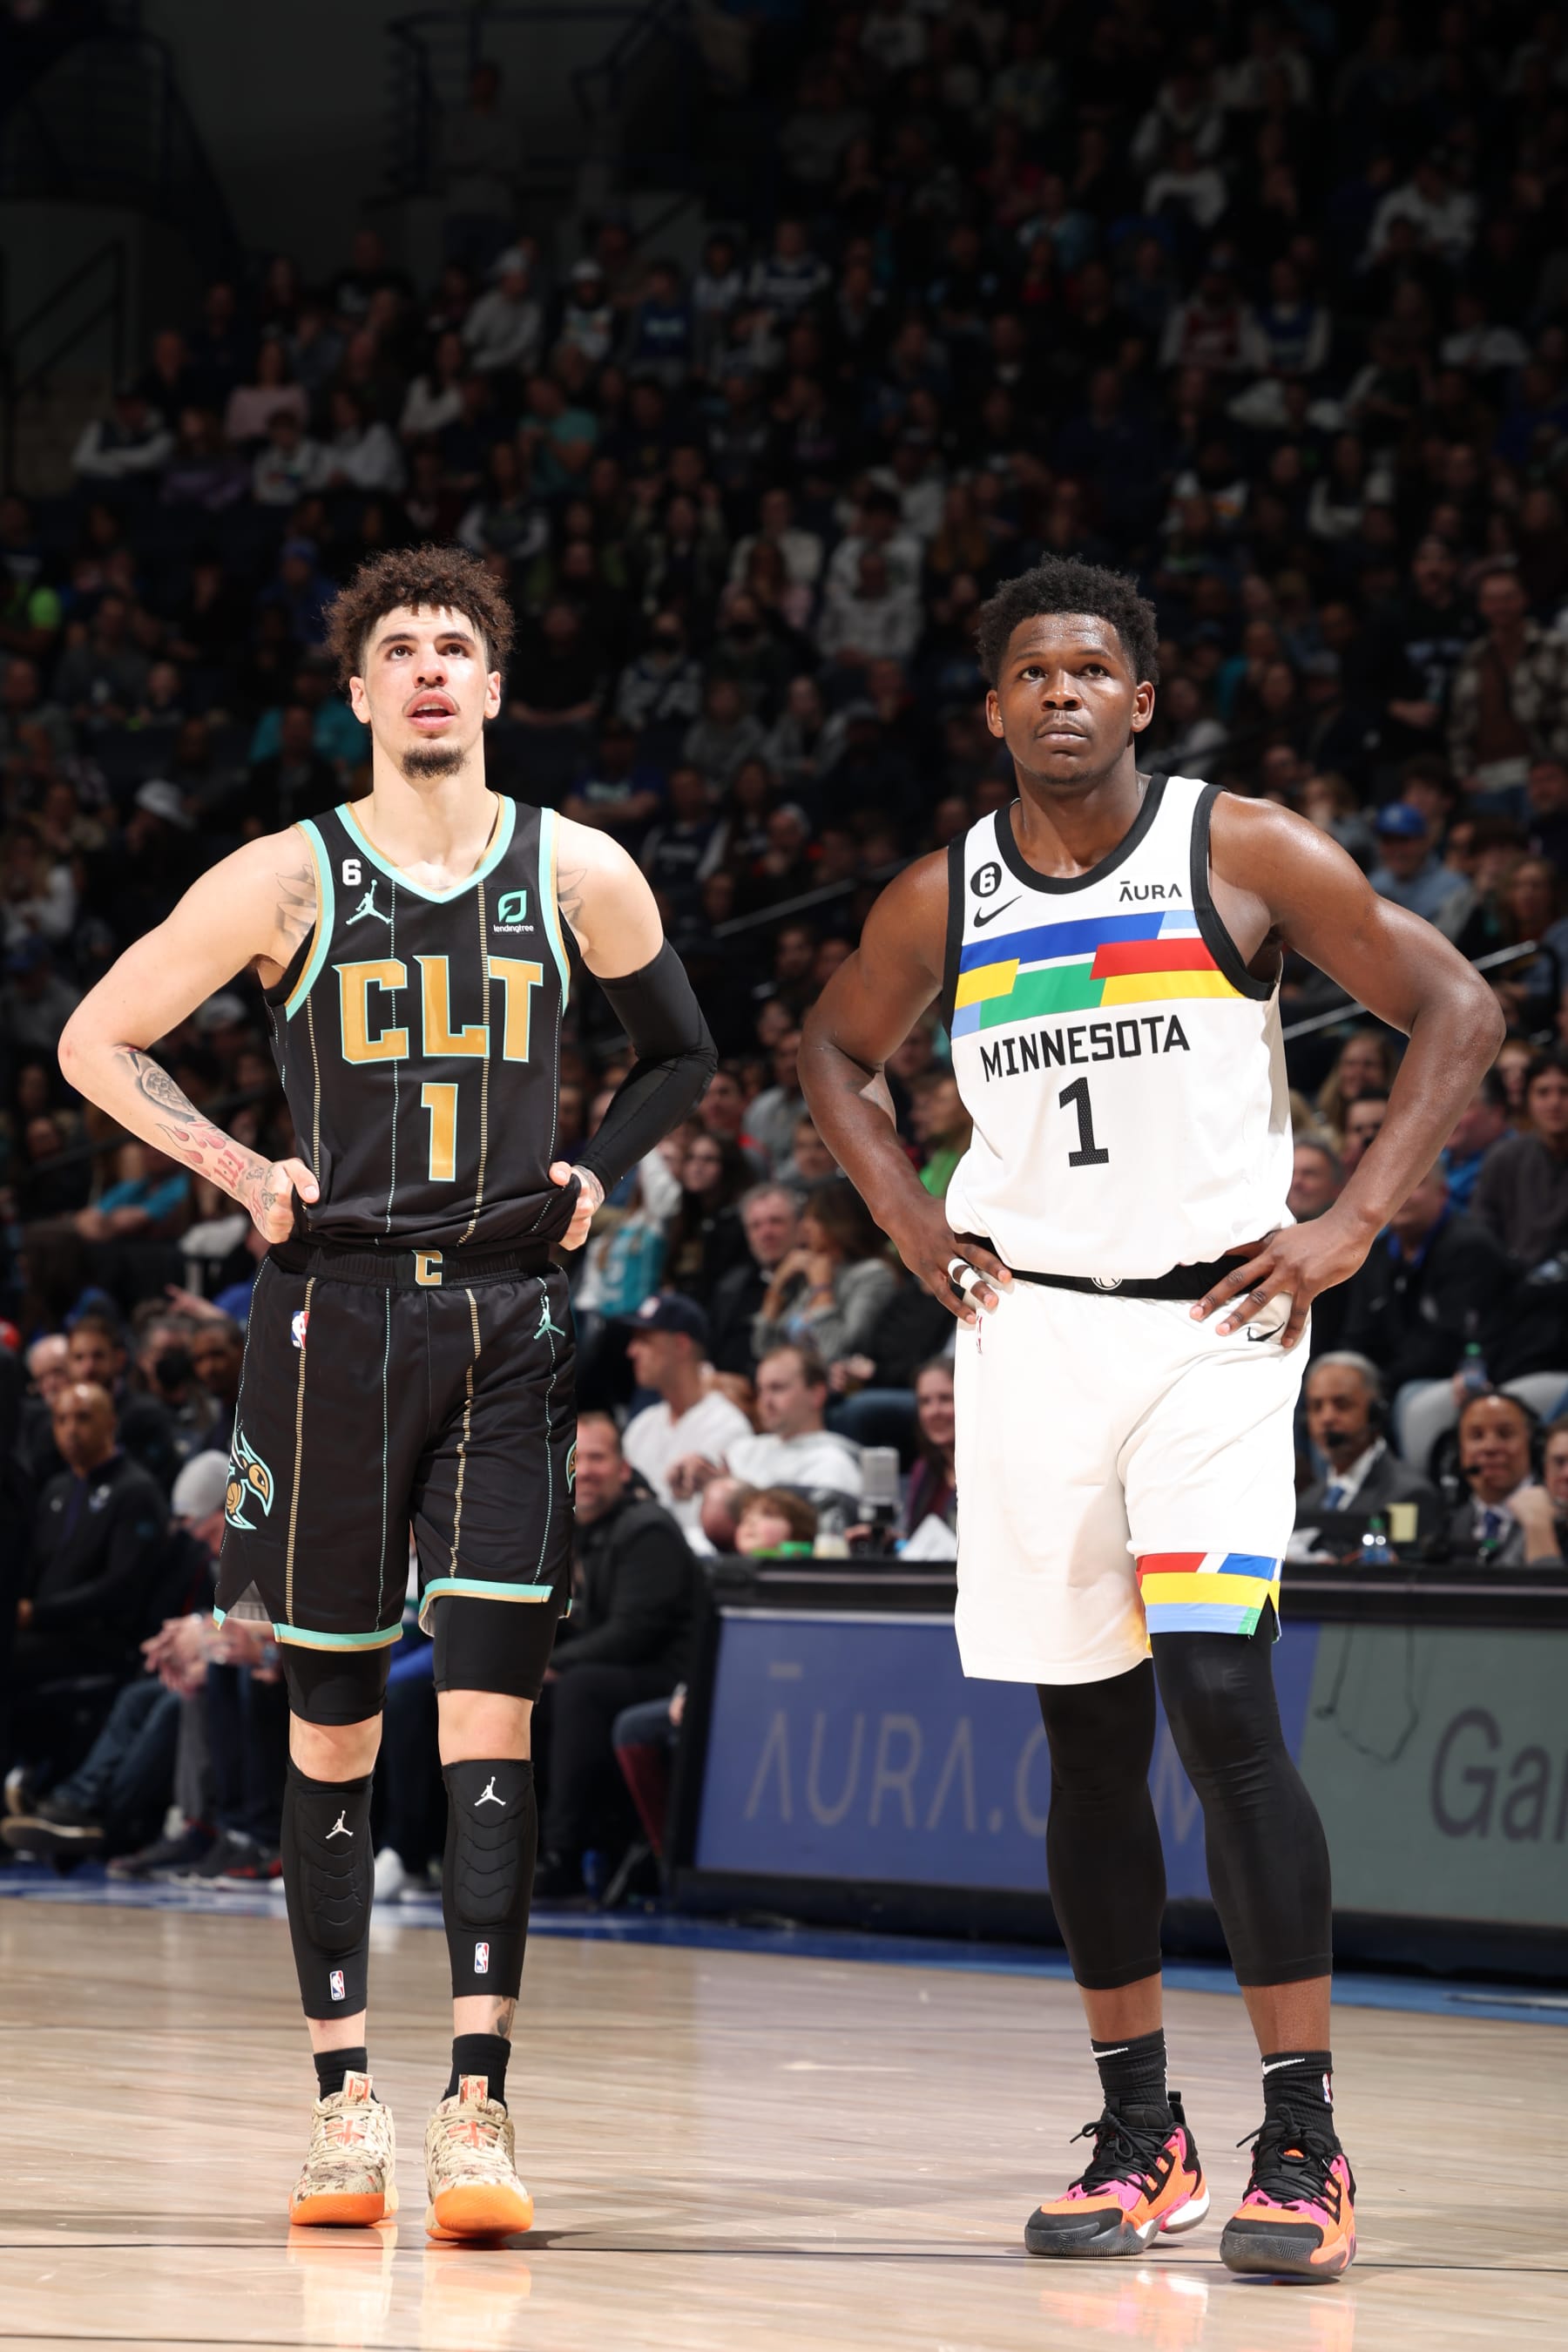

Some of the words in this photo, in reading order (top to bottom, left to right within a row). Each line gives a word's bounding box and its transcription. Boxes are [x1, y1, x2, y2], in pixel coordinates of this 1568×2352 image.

[342, 859, 362, 886] 6
[979, 866, 996, 895] 6
[493, 924, 534, 933] lendingtree
[332, 955, 544, 1064] CLT
[980, 1015, 1191, 1082] MINNESOTA
[421, 1083, 458, 1181] 1
[1058, 1077, 1109, 1167] 1
[413, 1250, 443, 1286] C
